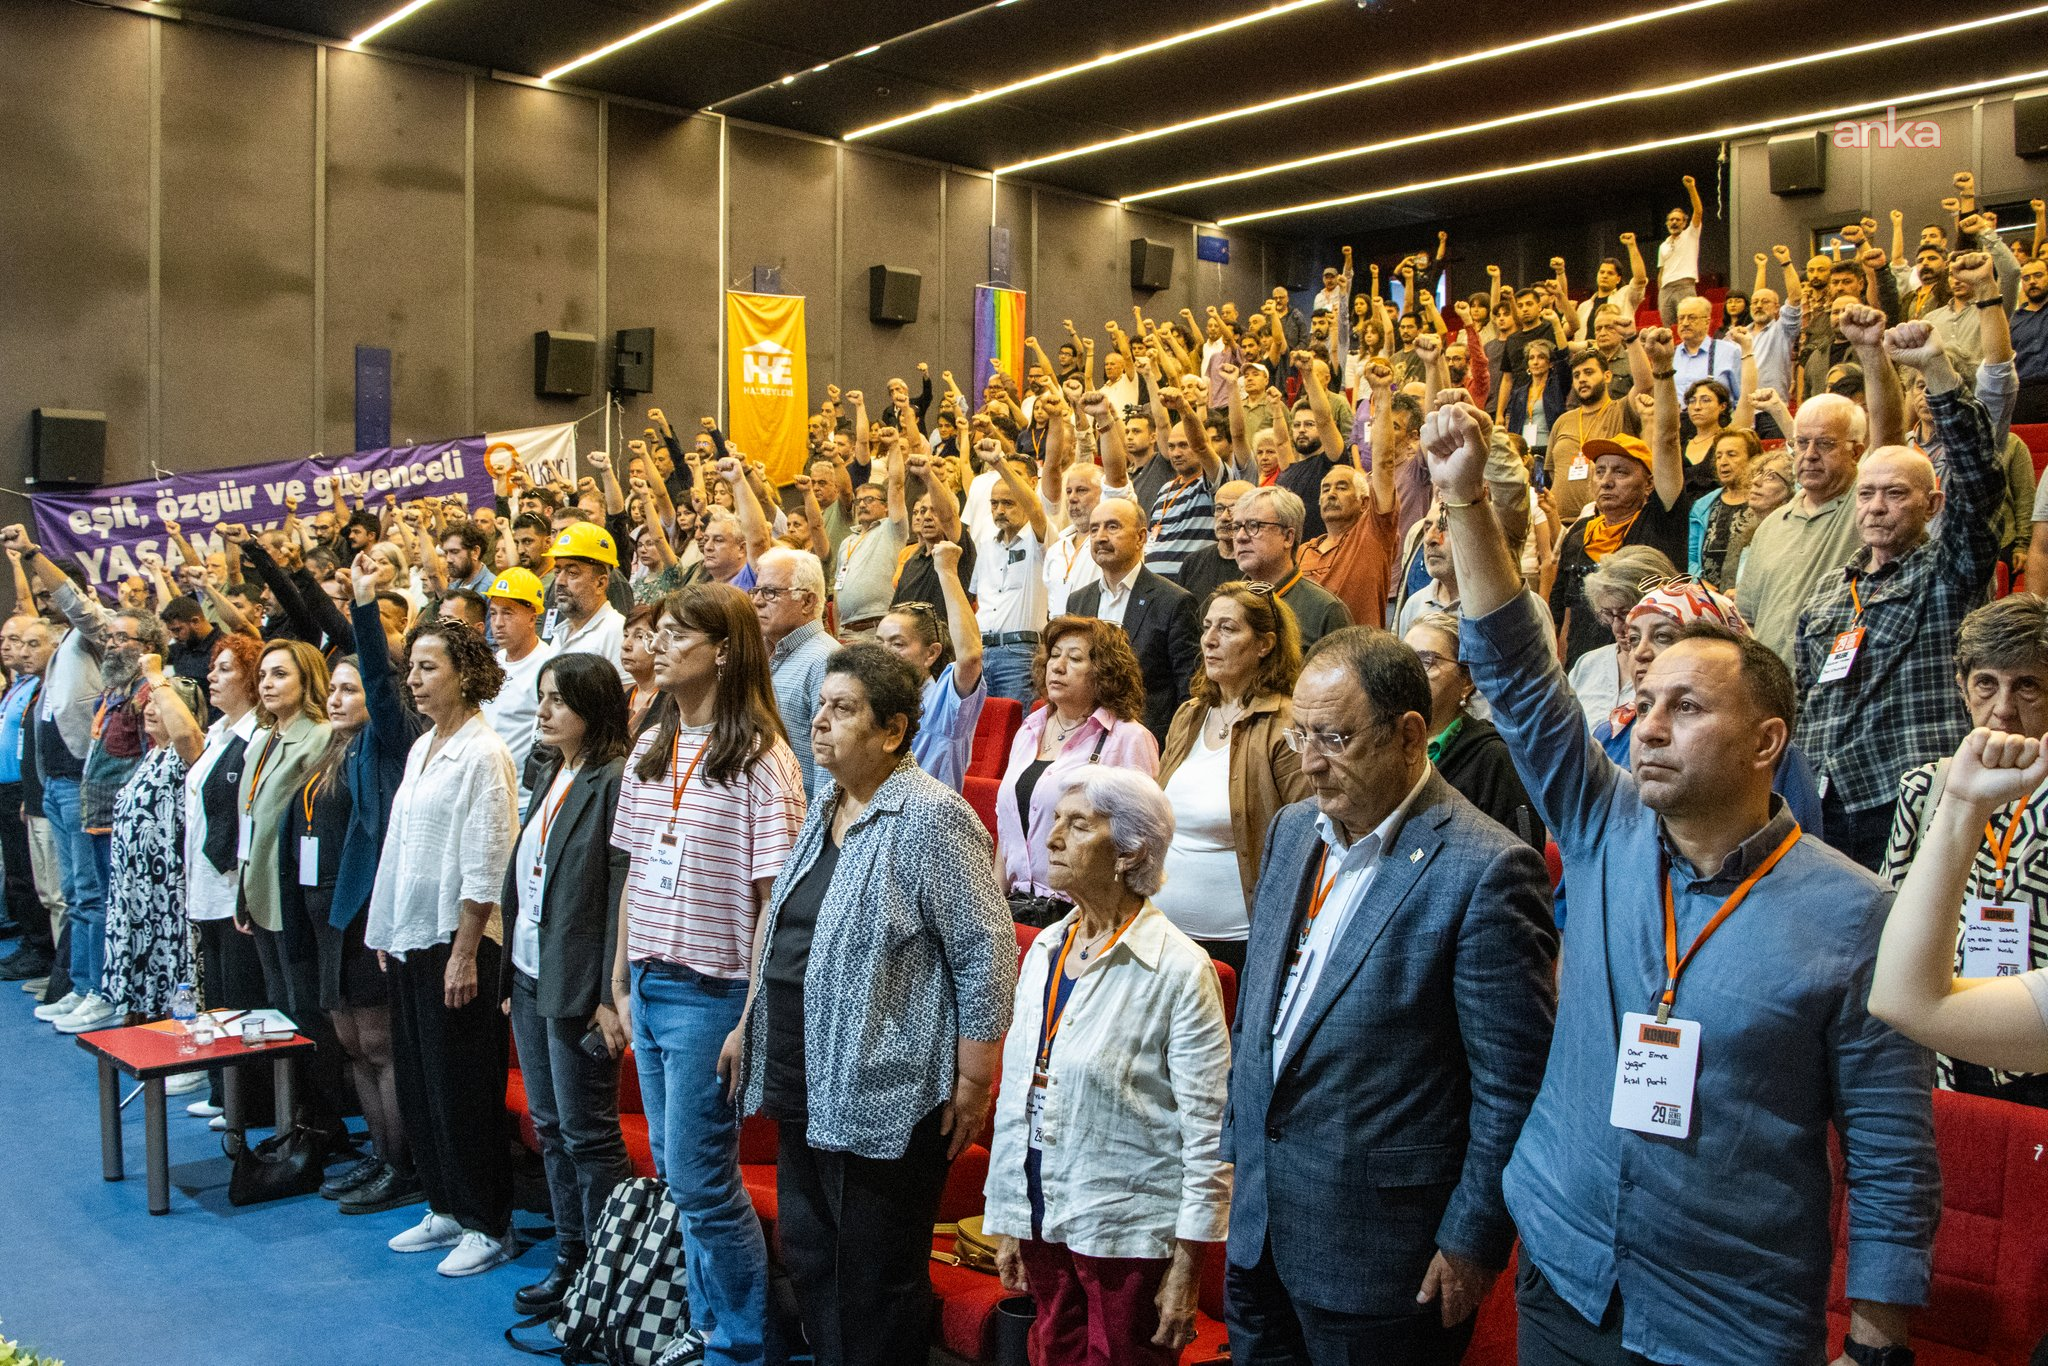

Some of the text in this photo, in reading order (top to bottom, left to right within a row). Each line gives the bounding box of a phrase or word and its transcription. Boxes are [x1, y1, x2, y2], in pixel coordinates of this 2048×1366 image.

[68, 449, 465, 539] eşit, özgür ve güvenceli
